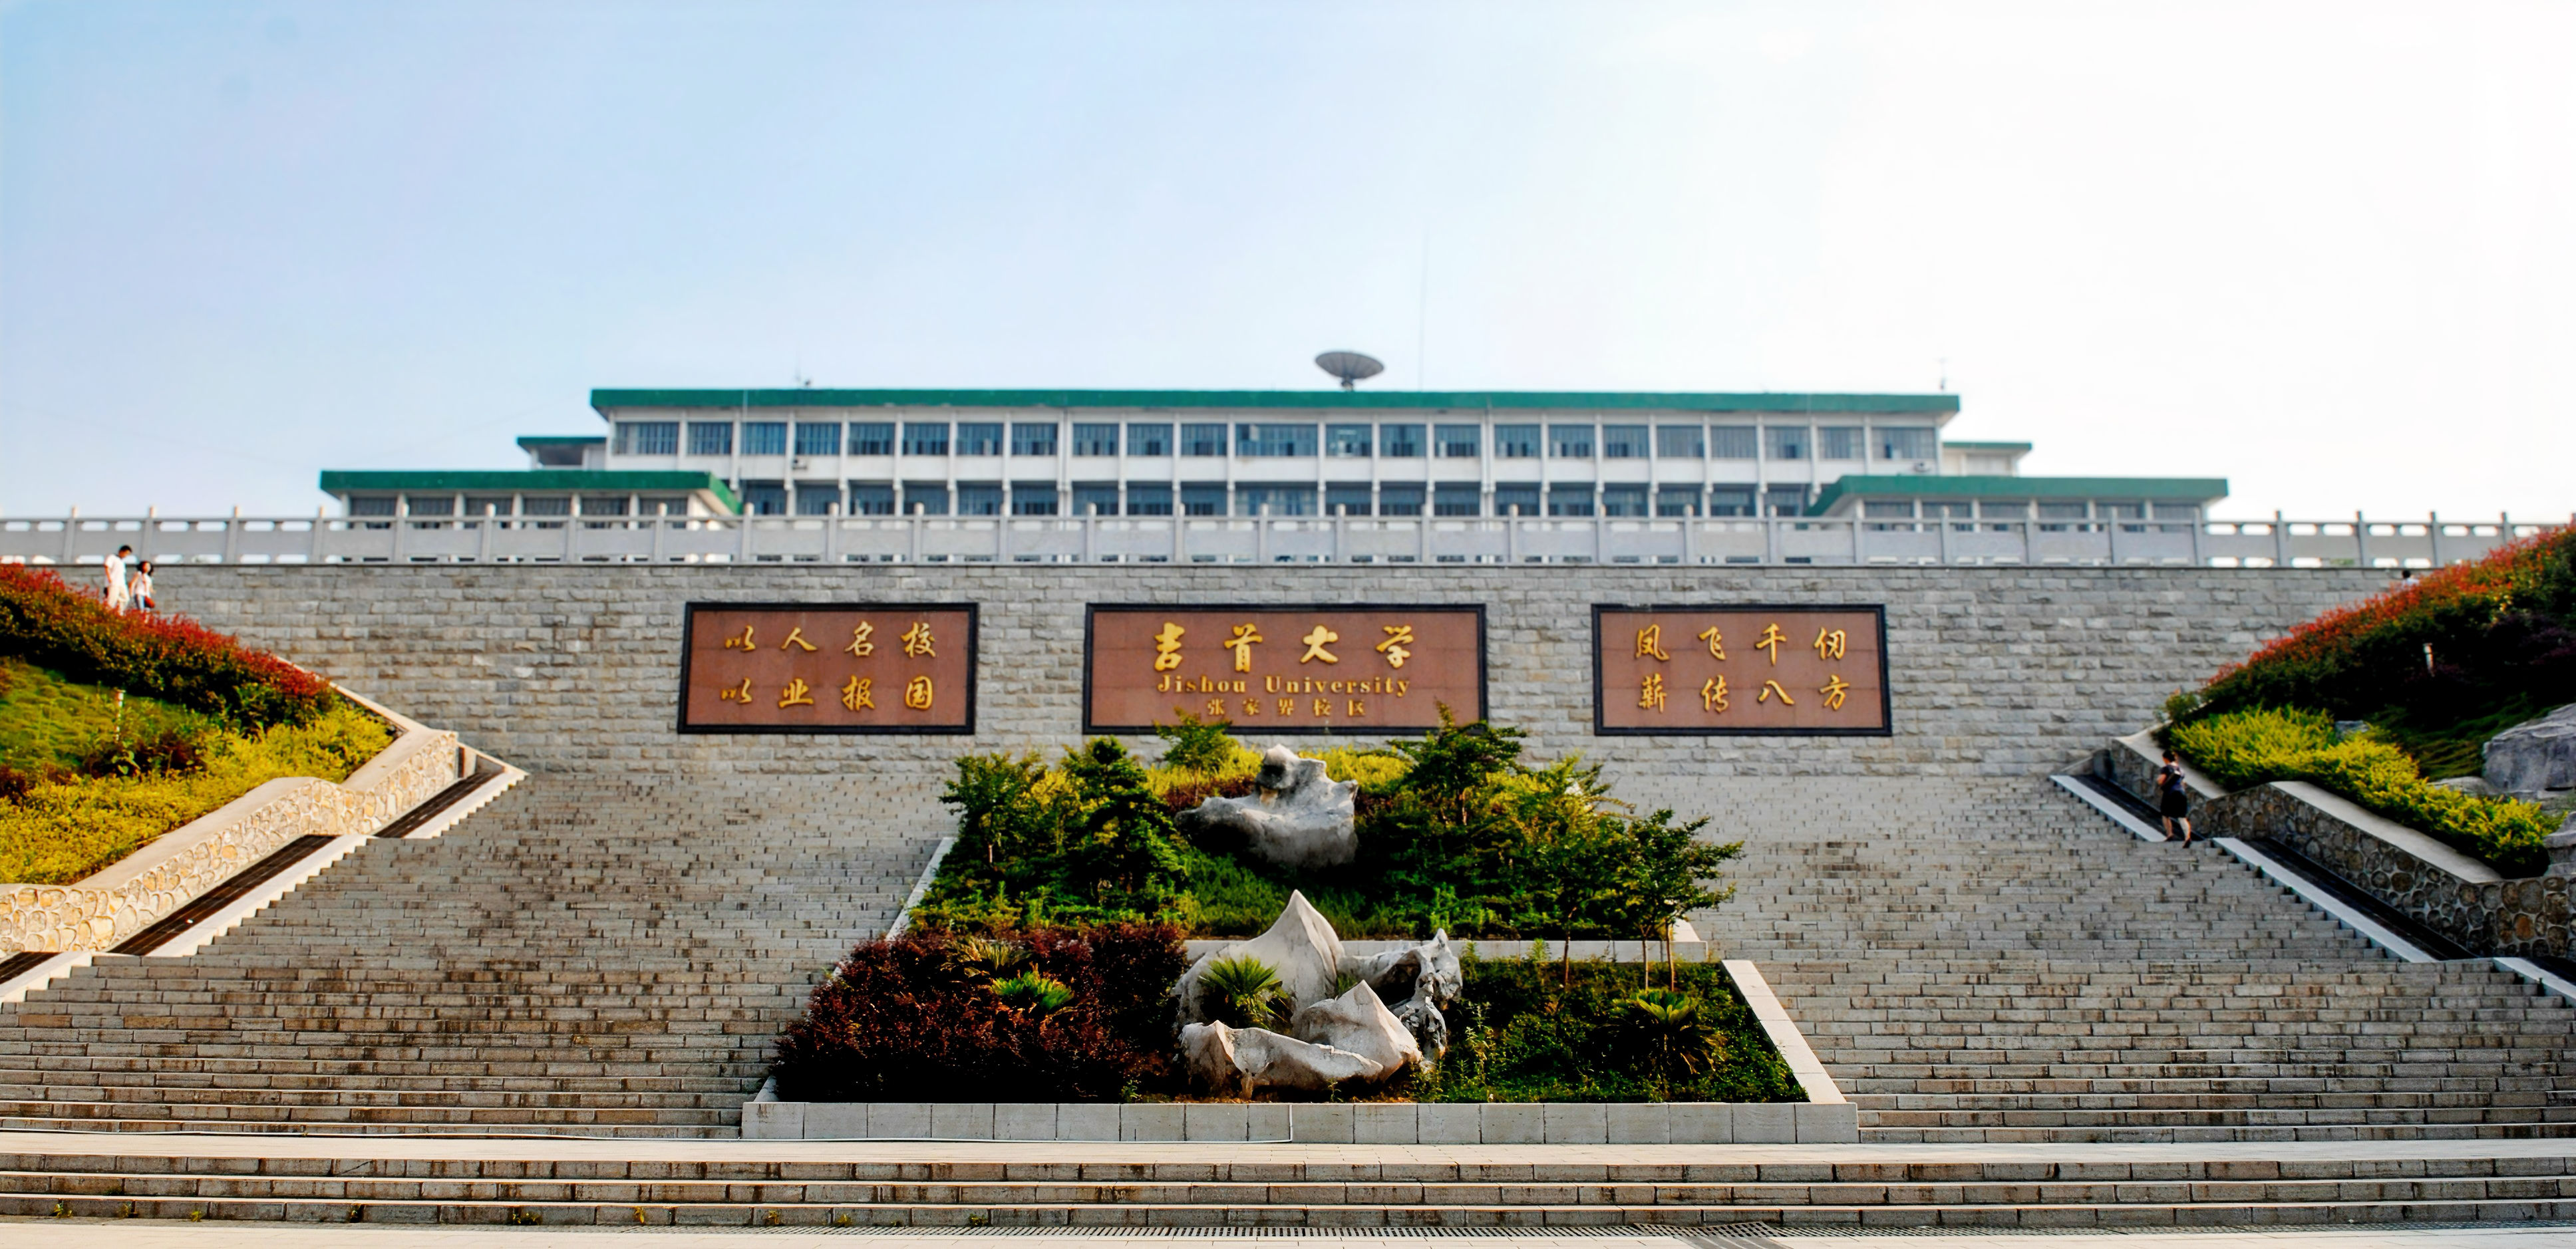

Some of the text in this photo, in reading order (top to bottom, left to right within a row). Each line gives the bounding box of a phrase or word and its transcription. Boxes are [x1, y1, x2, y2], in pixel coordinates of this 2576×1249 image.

[724, 621, 936, 658] 以人名校
[1154, 623, 1414, 672] 吉首大学
[1635, 623, 1847, 665] 凤飞千仞
[721, 675, 933, 710] 以业报国
[1157, 674, 1411, 697] Jishou University
[1638, 672, 1850, 714] 薪传八方
[1208, 698, 1366, 716] 张家界校区
